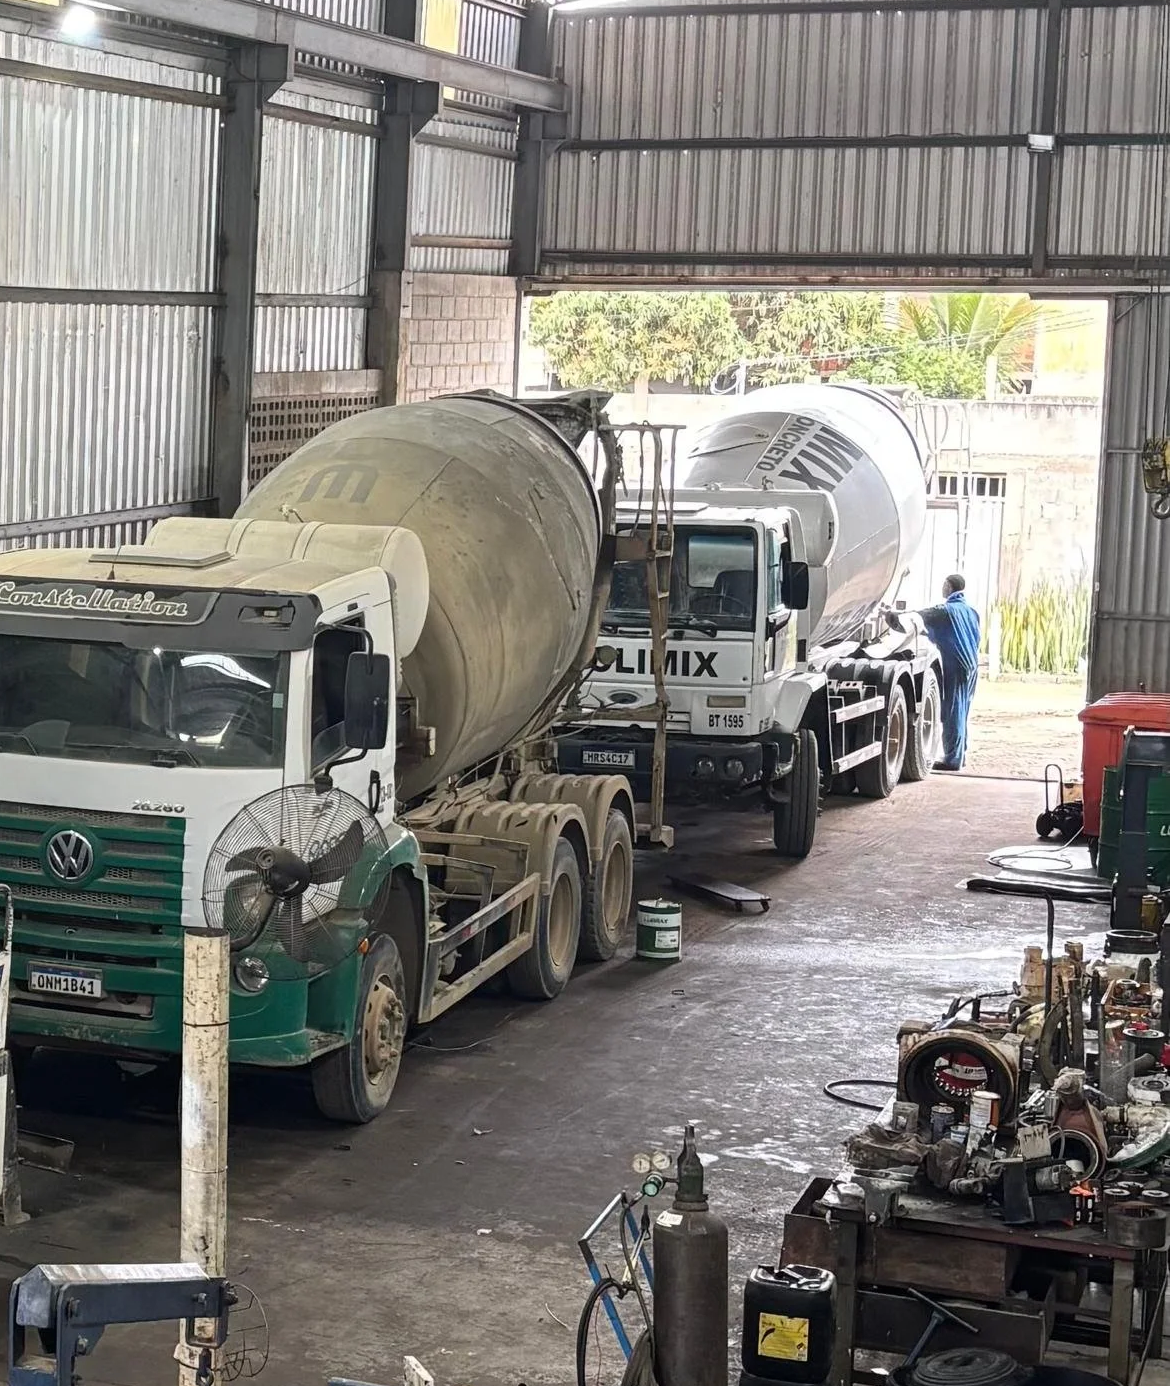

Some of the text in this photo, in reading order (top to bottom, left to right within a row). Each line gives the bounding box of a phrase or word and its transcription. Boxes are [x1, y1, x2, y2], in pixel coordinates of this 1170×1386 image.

[756, 416, 815, 471] ONCRETO
[778, 426, 864, 492] MIX
[708, 715, 720, 728] BT
[723, 715, 744, 729] 1595
